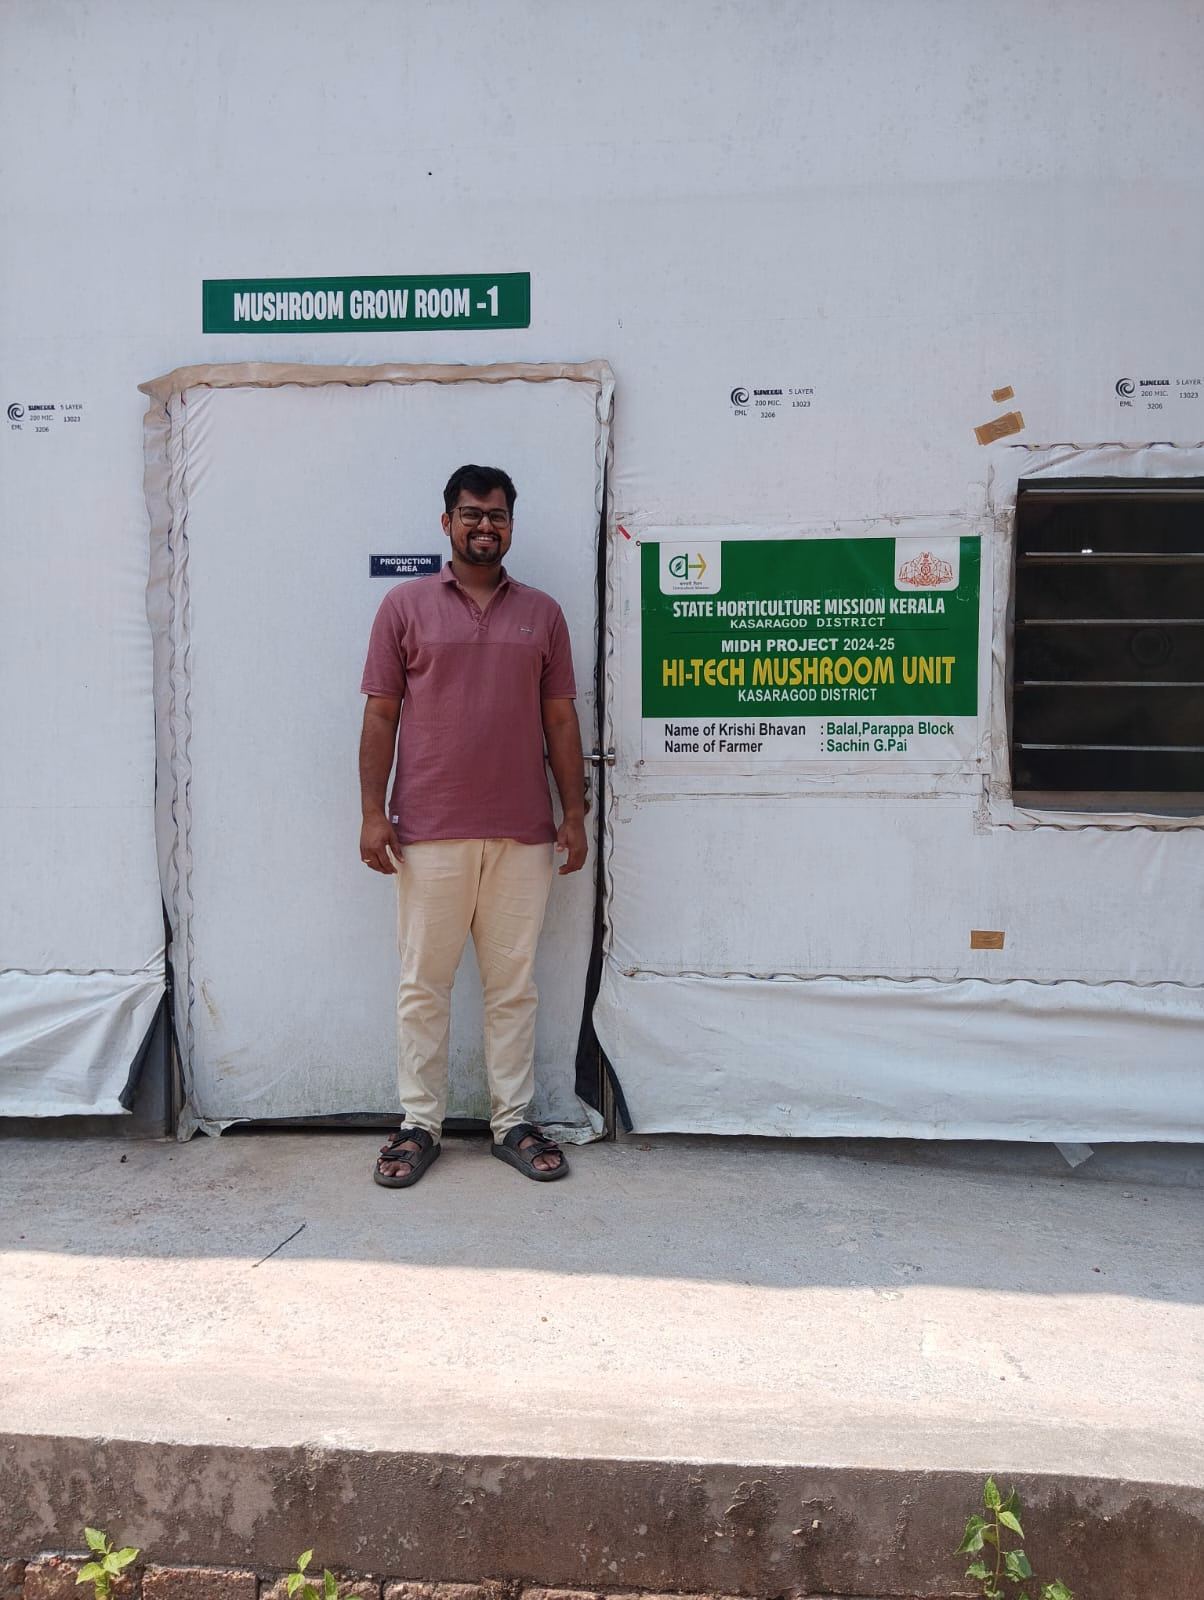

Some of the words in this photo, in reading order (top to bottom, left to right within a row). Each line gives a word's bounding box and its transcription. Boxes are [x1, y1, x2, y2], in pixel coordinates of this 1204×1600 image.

[233, 291, 344, 321] MUSHROOM
[350, 290, 409, 319] GROW
[414, 288, 471, 317] ROOM
[476, 285, 499, 316] -1
[380, 557, 432, 565] PRODUCTION
[673, 601, 713, 617] STATE
[717, 600, 821, 616] HORTICULTURE
[825, 598, 886, 615] MISSION
[889, 598, 945, 614] KERALA
[730, 619, 807, 629] KASARAGOD
[816, 617, 885, 627] DISTRICT
[721, 640, 761, 652] MIDH
[766, 638, 839, 652] PROJECT
[843, 638, 895, 650] 2024-25
[662, 659, 745, 686] HI-TECH
[752, 656, 895, 686] MUSHROOM
[902, 656, 956, 684] UNIT
[738, 688, 817, 702] KASARAGOD
[821, 688, 877, 701] DISTRICT
[665, 723, 699, 736] Name
[703, 723, 716, 736] of
[719, 723, 755, 736] Krishi
[759, 723, 806, 736] Bhavan
[918, 722, 954, 735] Block
[665, 740, 699, 752] Name
[703, 740, 716, 752] of
[719, 740, 763, 752] Farmer
[873, 739, 907, 752] G.Pai
